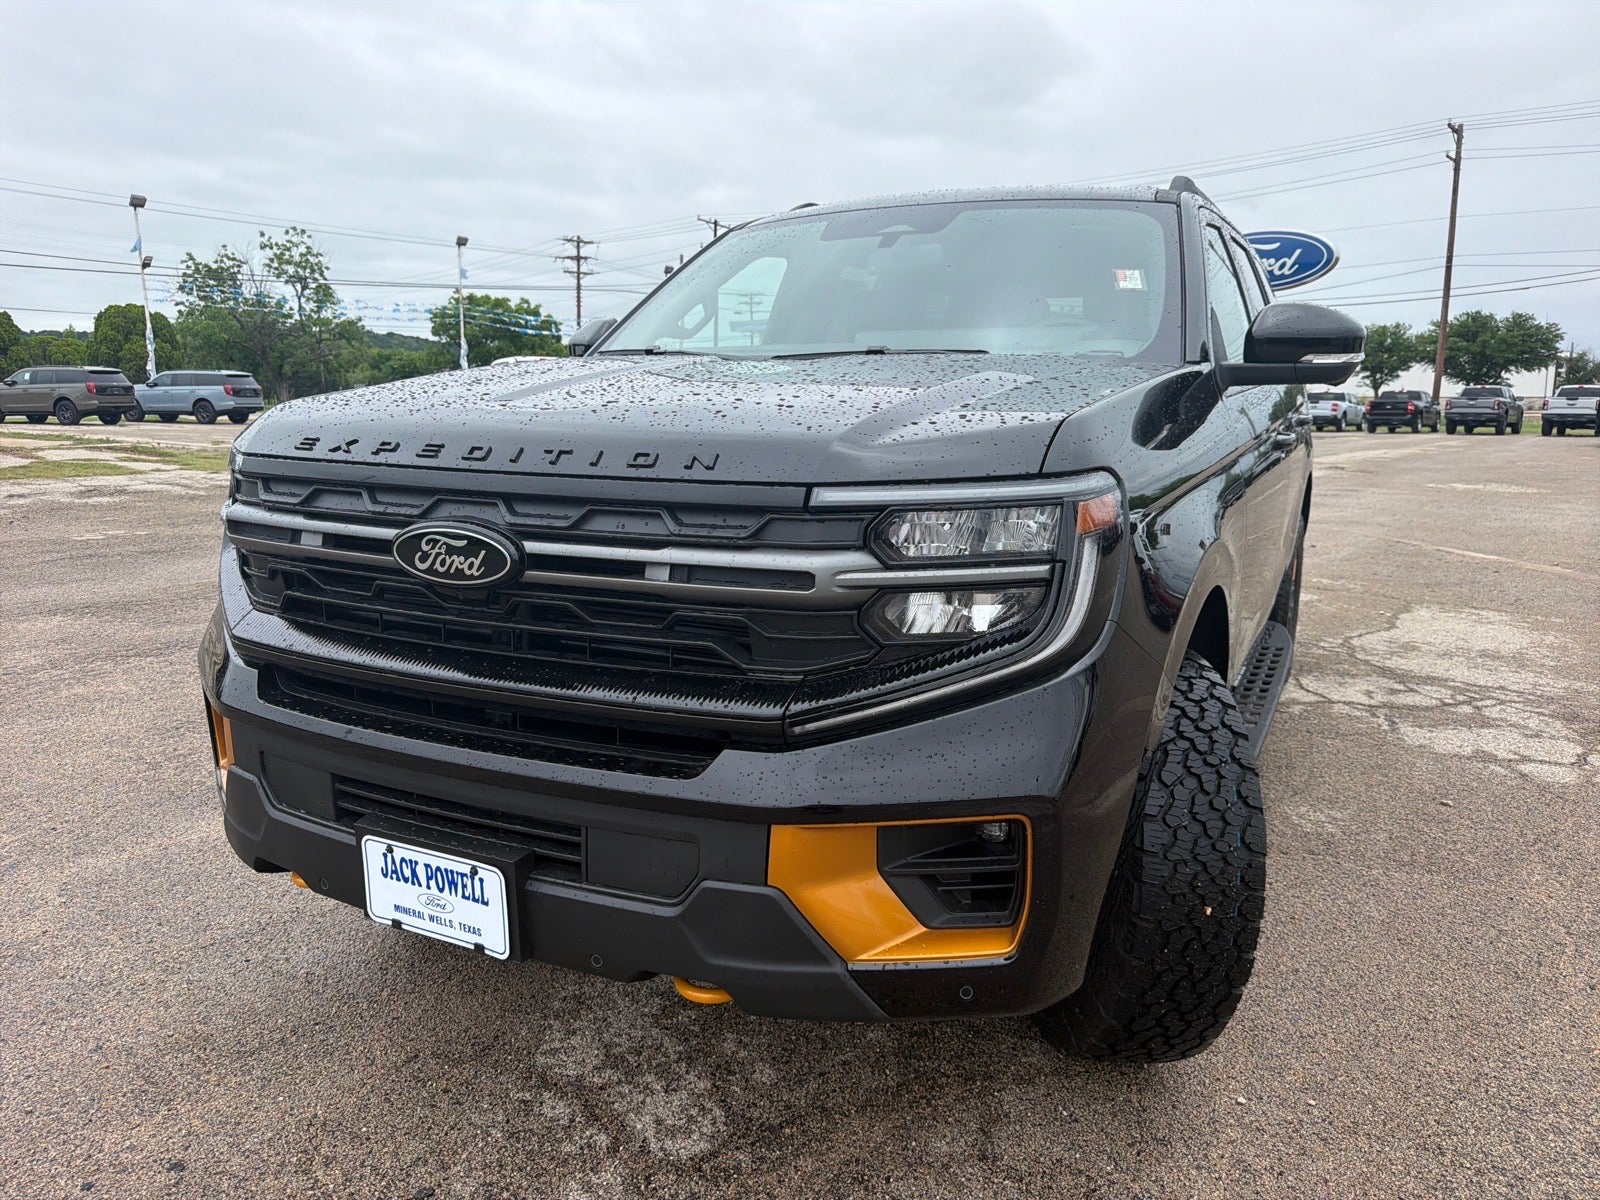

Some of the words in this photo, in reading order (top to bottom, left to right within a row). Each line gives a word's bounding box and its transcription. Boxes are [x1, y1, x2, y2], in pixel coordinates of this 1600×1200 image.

[294, 436, 721, 471] EXPEDITION
[415, 535, 485, 576] Ford
[381, 852, 422, 887] JACK
[424, 863, 489, 907] POWELL
[394, 904, 426, 920] MINERAL
[428, 913, 456, 930] WELLS,
[459, 922, 482, 937] TEXAS
[425, 896, 447, 911] Ford
